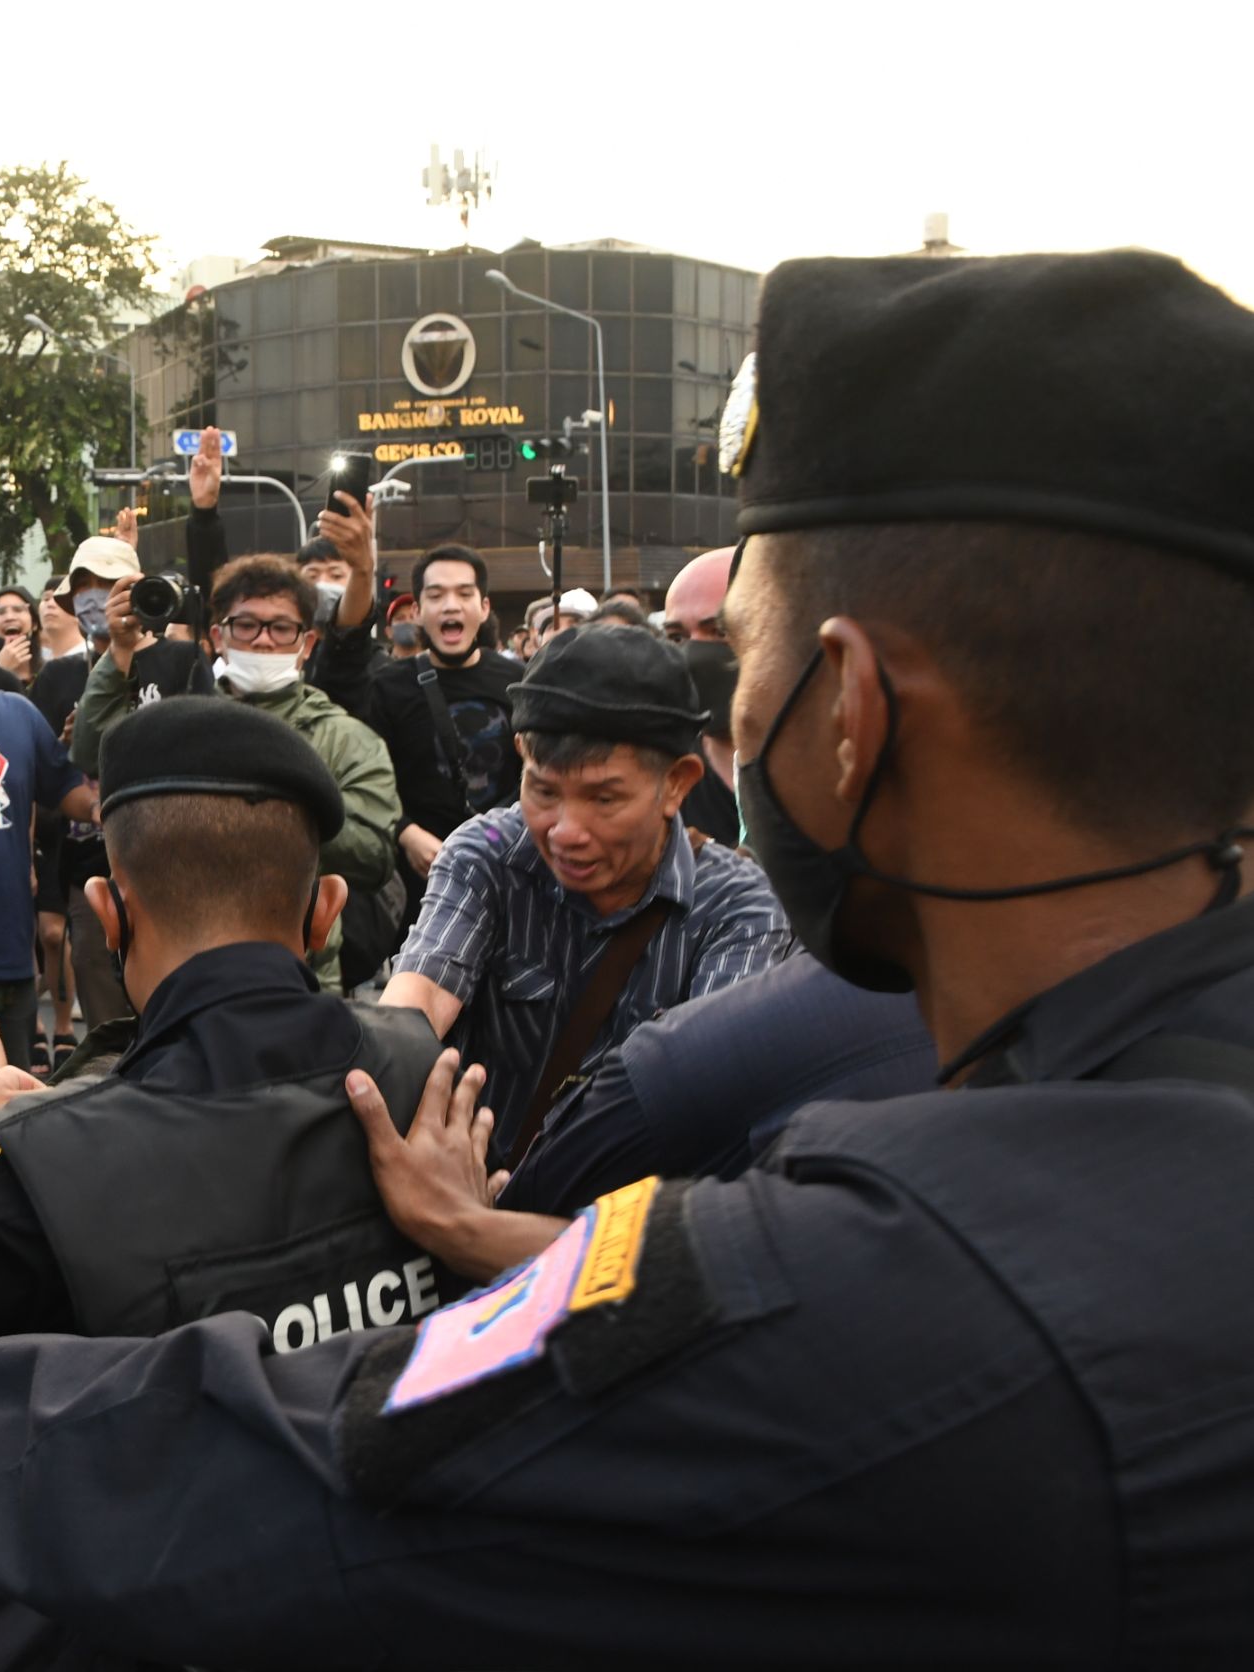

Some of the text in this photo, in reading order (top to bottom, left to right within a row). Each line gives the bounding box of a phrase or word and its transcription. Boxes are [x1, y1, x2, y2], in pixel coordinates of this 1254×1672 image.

[358, 406, 524, 431] BANGKK ROYAL
[375, 443, 430, 462] GEMS
[254, 1255, 439, 1354] OLICE
